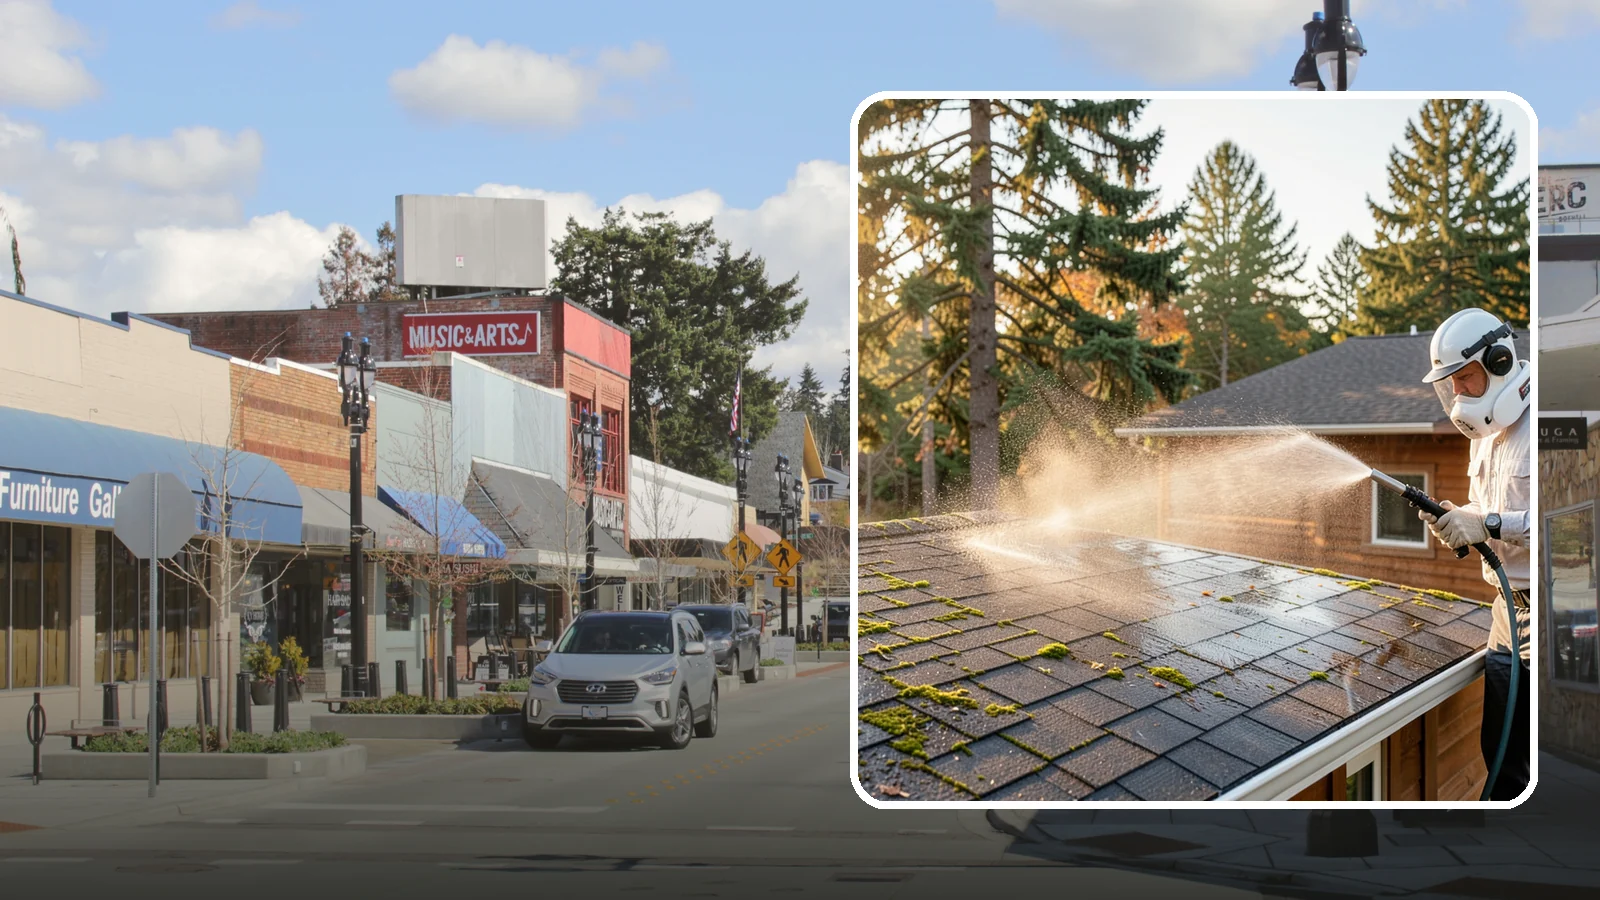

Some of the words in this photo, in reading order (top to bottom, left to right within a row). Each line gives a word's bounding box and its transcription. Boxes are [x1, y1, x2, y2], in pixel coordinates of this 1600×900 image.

[409, 322, 520, 349] MUSIC&ARTS
[1540, 427, 1577, 437] UGA
[0, 471, 79, 516] Furniture
[89, 482, 122, 519] Gal
